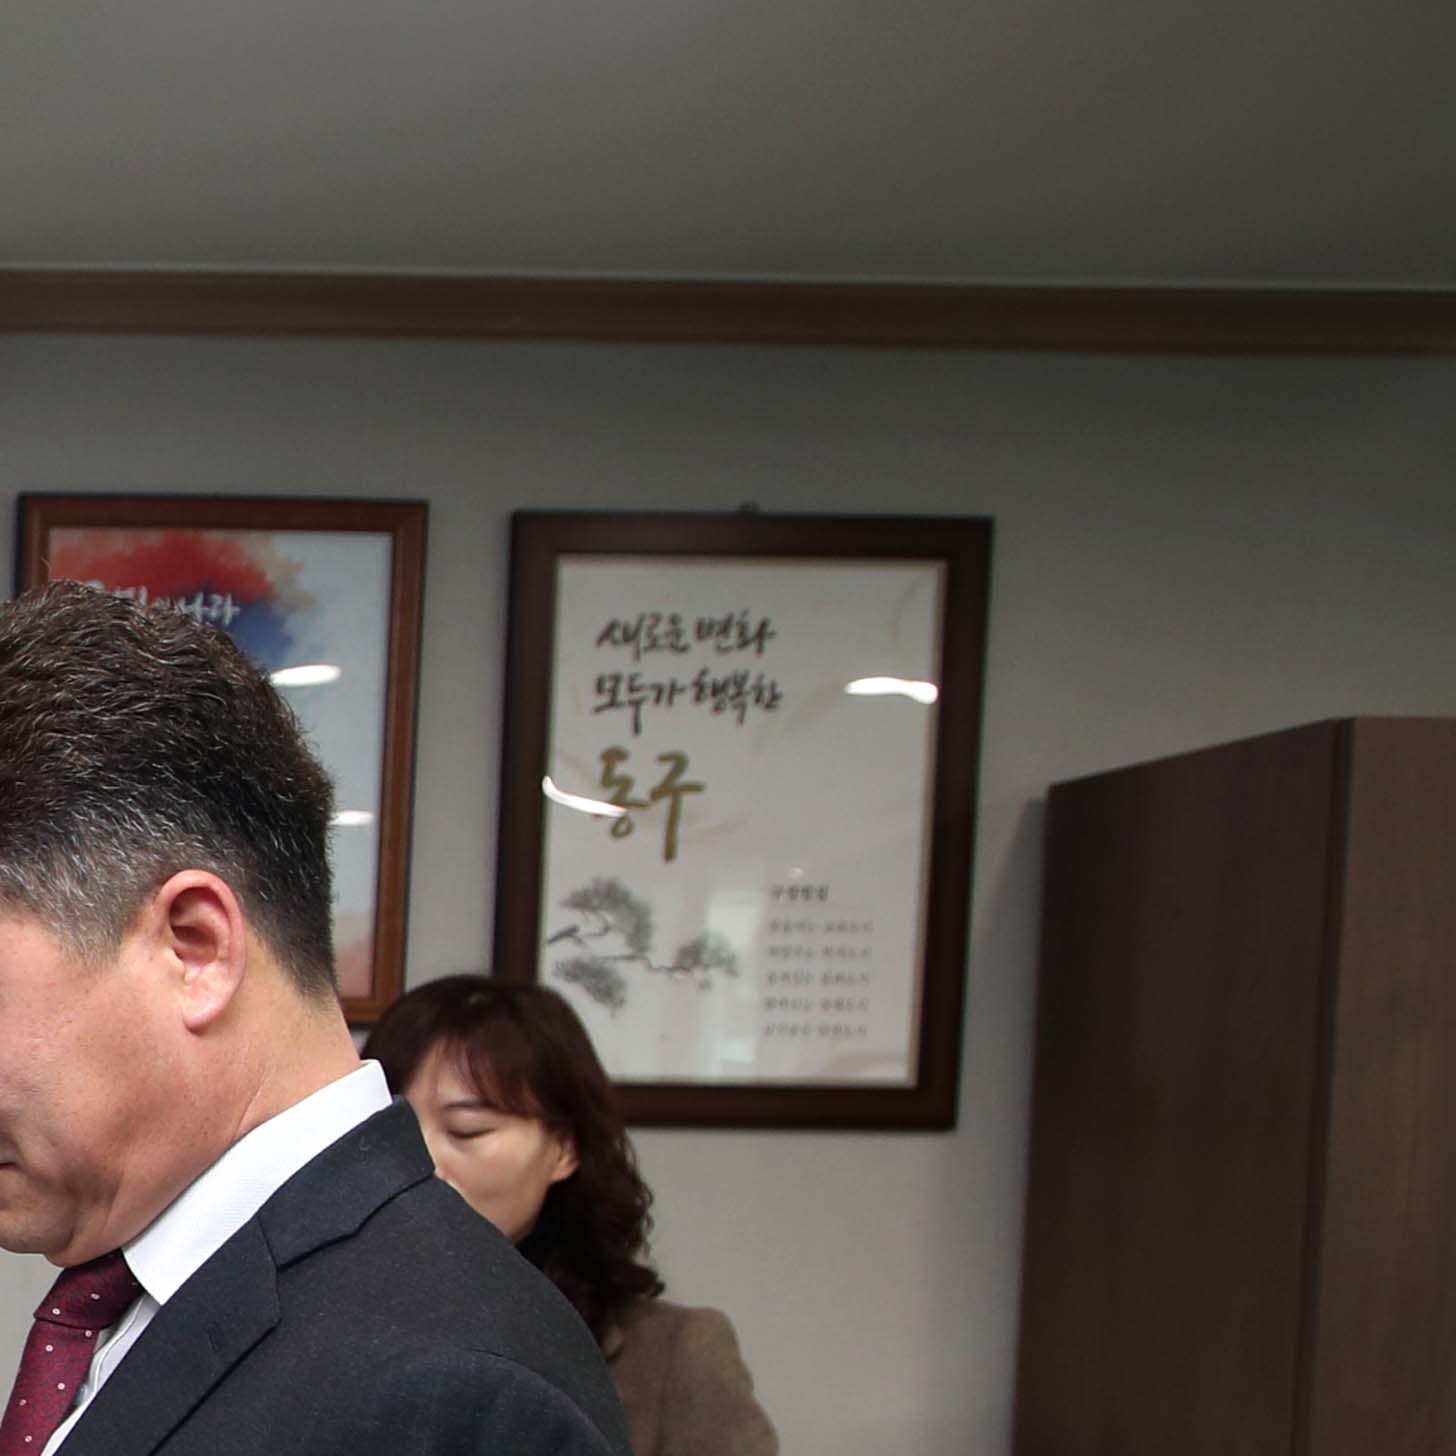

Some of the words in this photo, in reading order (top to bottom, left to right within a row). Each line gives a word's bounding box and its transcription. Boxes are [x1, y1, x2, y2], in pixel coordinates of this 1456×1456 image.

[595, 612, 690, 663] 새로운
[694, 609, 777, 657] 변화
[594, 672, 689, 738] 모두가
[692, 667, 783, 727] 행복한
[600, 745, 706, 864] 동구
